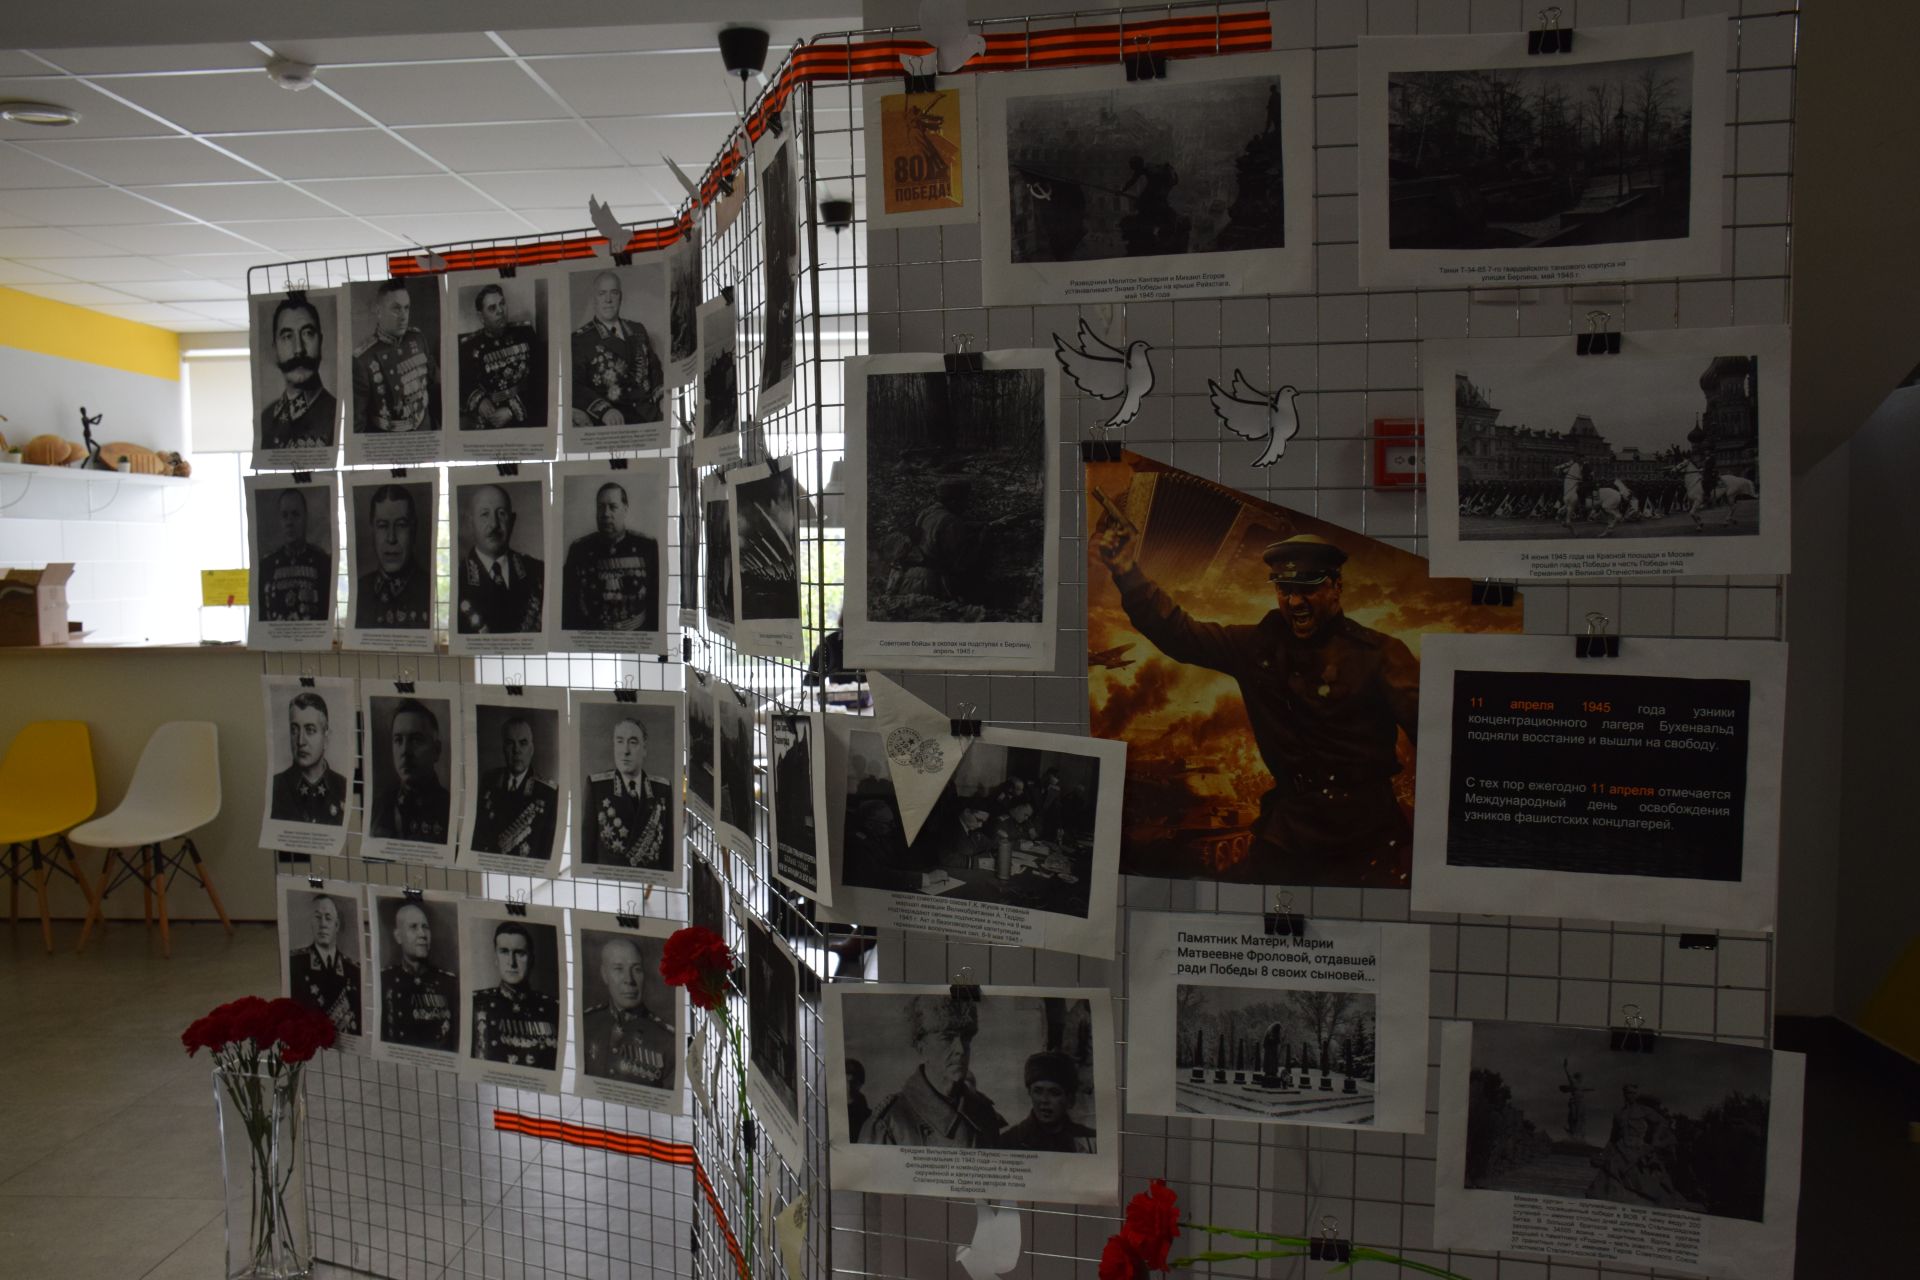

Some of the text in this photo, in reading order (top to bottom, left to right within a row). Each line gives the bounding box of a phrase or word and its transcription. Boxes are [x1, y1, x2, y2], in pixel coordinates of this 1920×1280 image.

[1471, 697, 1735, 719] 11 апреля 1945 года узники
[1468, 715, 1734, 737] концентрационного лагеря Бухенвальд
[1468, 732, 1719, 752] подняли восстание и вышли на свободу.
[1466, 777, 1731, 799] С тех пор ежегодно 11 апреля отмечается
[1465, 793, 1730, 816] Международный день освобождения
[1465, 812, 1674, 831] узников фашистских концлагерей.
[1178, 932, 1333, 950] Памятник Матери, Марии
[1178, 947, 1375, 966] Матвеевне Фроловой, отдавшей
[1177, 964, 1375, 981] ради Победы 8 своих сыновей...
